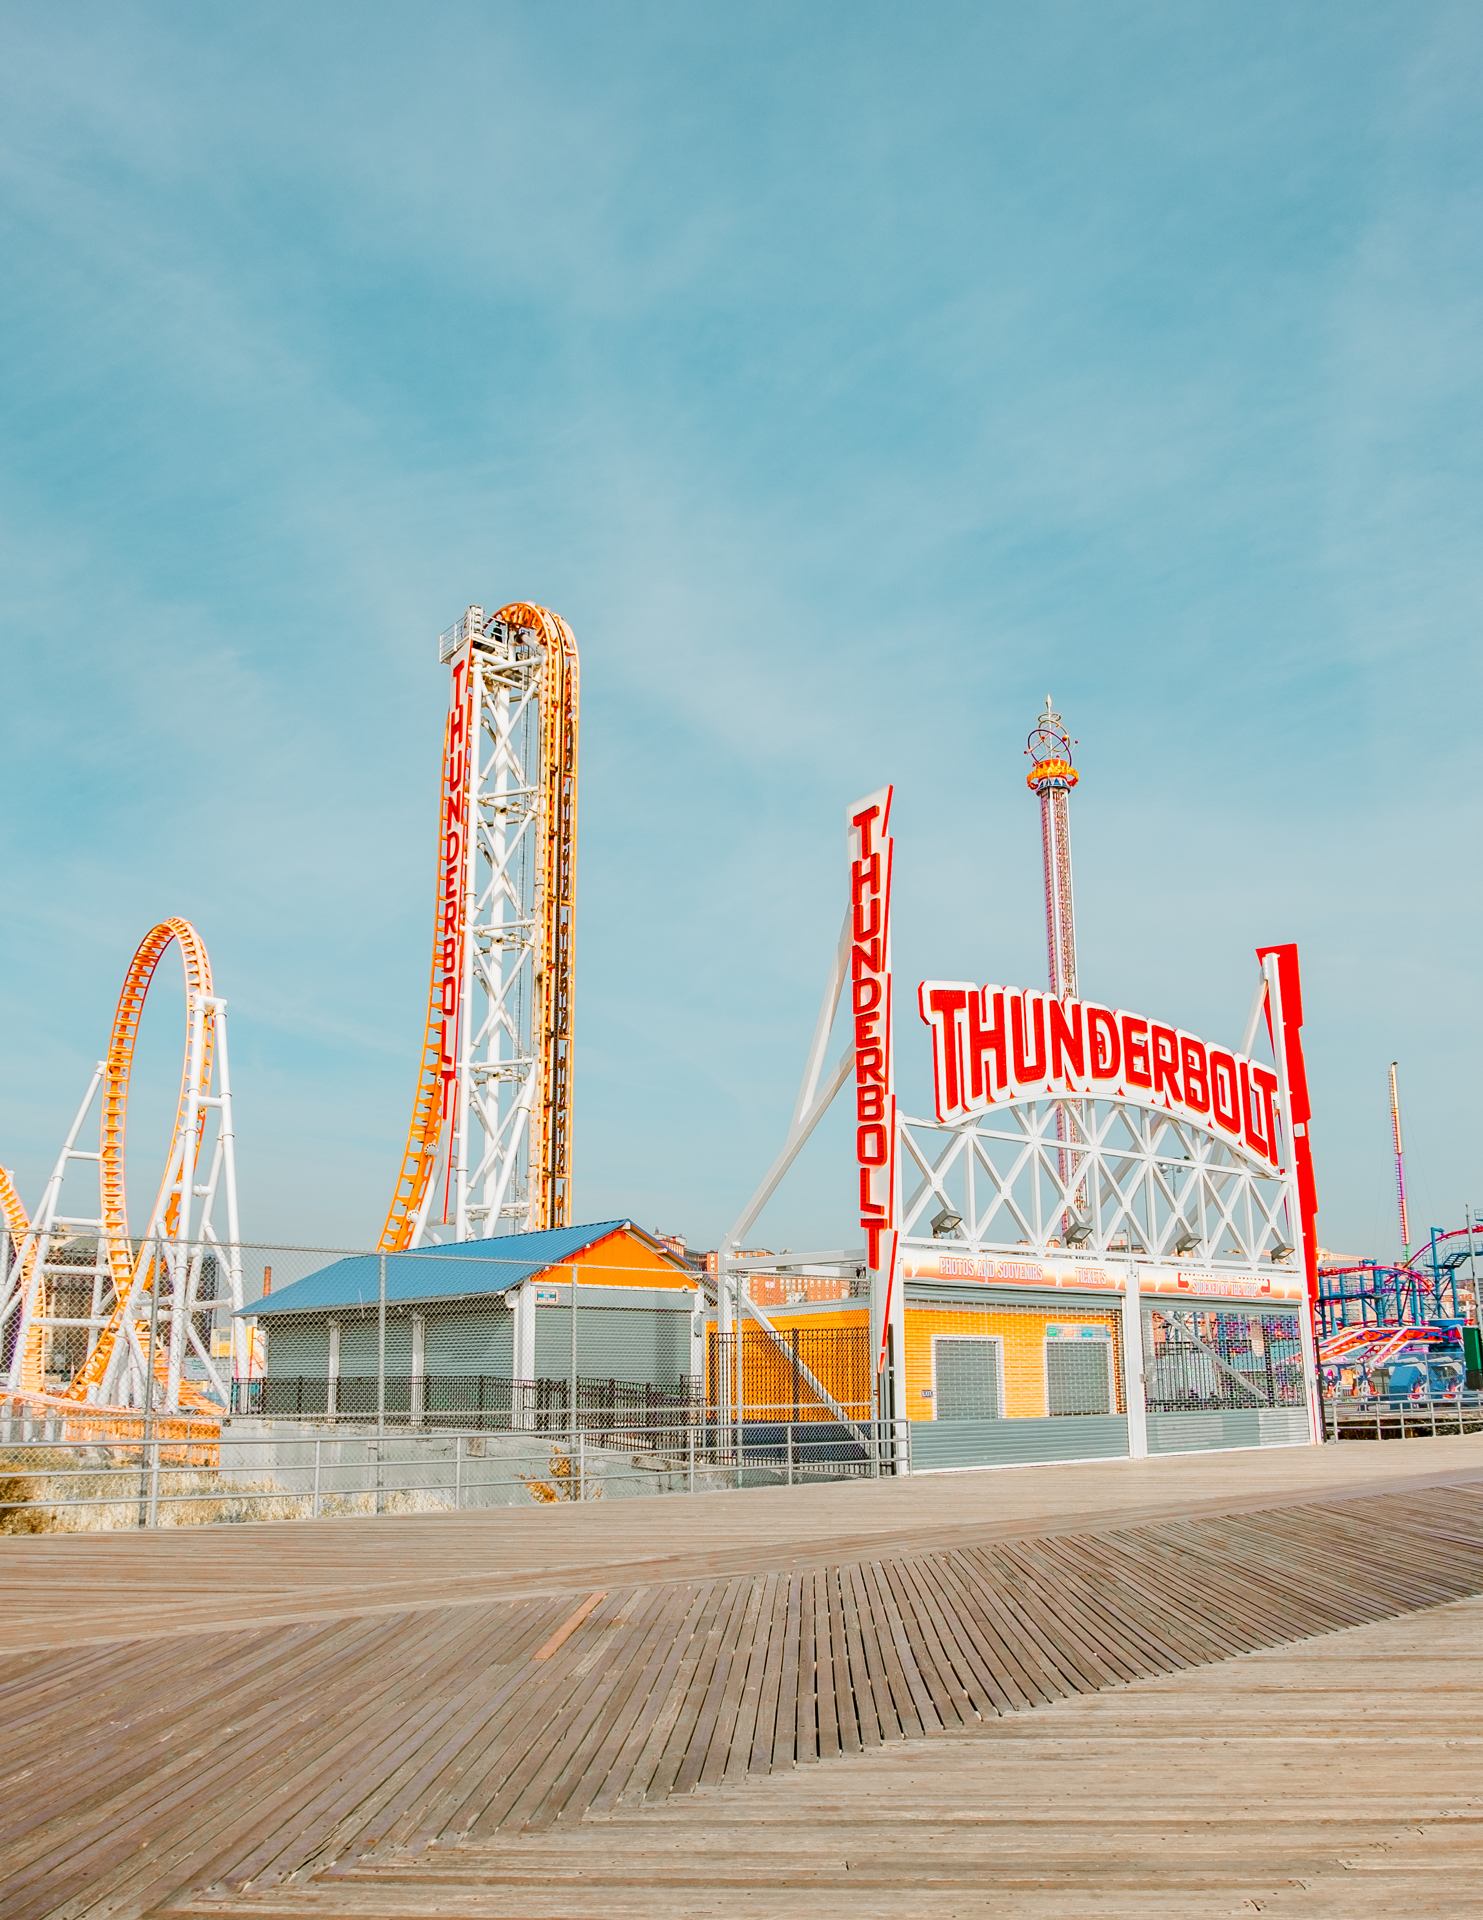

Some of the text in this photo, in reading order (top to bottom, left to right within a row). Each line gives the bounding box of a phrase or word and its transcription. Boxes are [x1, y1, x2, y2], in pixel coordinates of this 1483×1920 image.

[440, 660, 465, 1120] THUNDERBOLT
[852, 805, 888, 1270] THUNDERBOLT
[928, 988, 1280, 1168] THUNDERBOLT
[939, 1256, 1043, 1281] PHOTOS AND SOUVENIRS
[1074, 1267, 1107, 1285] TICKETS
